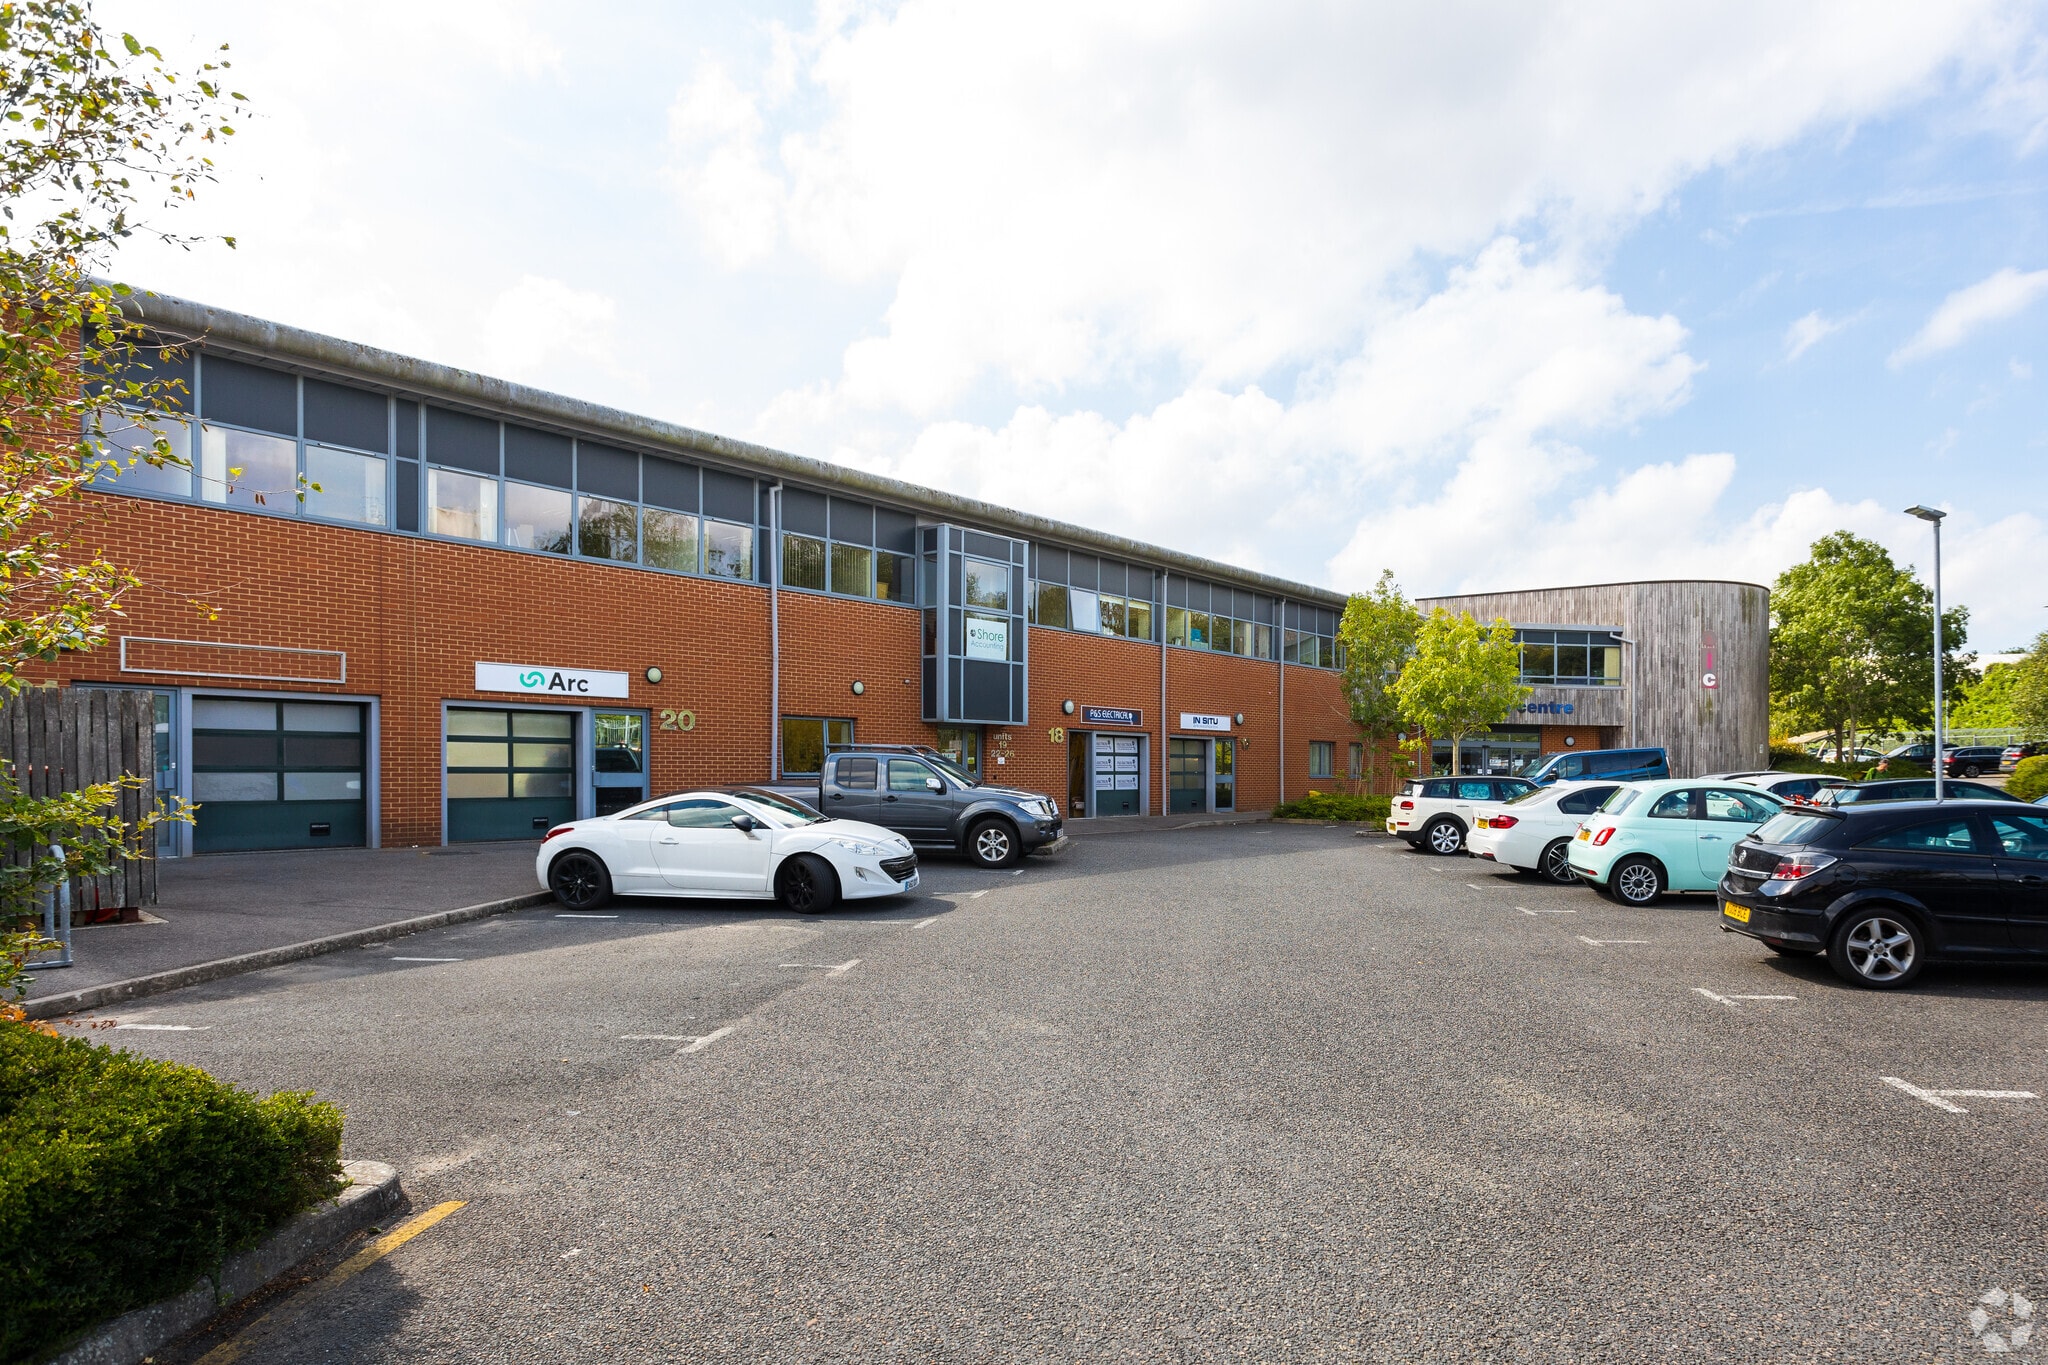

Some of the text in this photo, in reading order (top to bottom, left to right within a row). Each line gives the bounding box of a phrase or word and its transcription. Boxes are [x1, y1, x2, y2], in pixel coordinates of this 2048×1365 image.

[976, 628, 1004, 643] Shore
[970, 641, 1004, 652] Accounting
[548, 672, 589, 693] Arc
[1090, 708, 1101, 718] P&S
[1516, 701, 1574, 715] centre
[659, 708, 696, 731] 20
[1192, 716, 1219, 725] IN SITU
[992, 733, 1012, 741] units
[1048, 727, 1064, 743] 18
[998, 740, 1007, 749] 19
[990, 749, 1015, 758] 22-26
